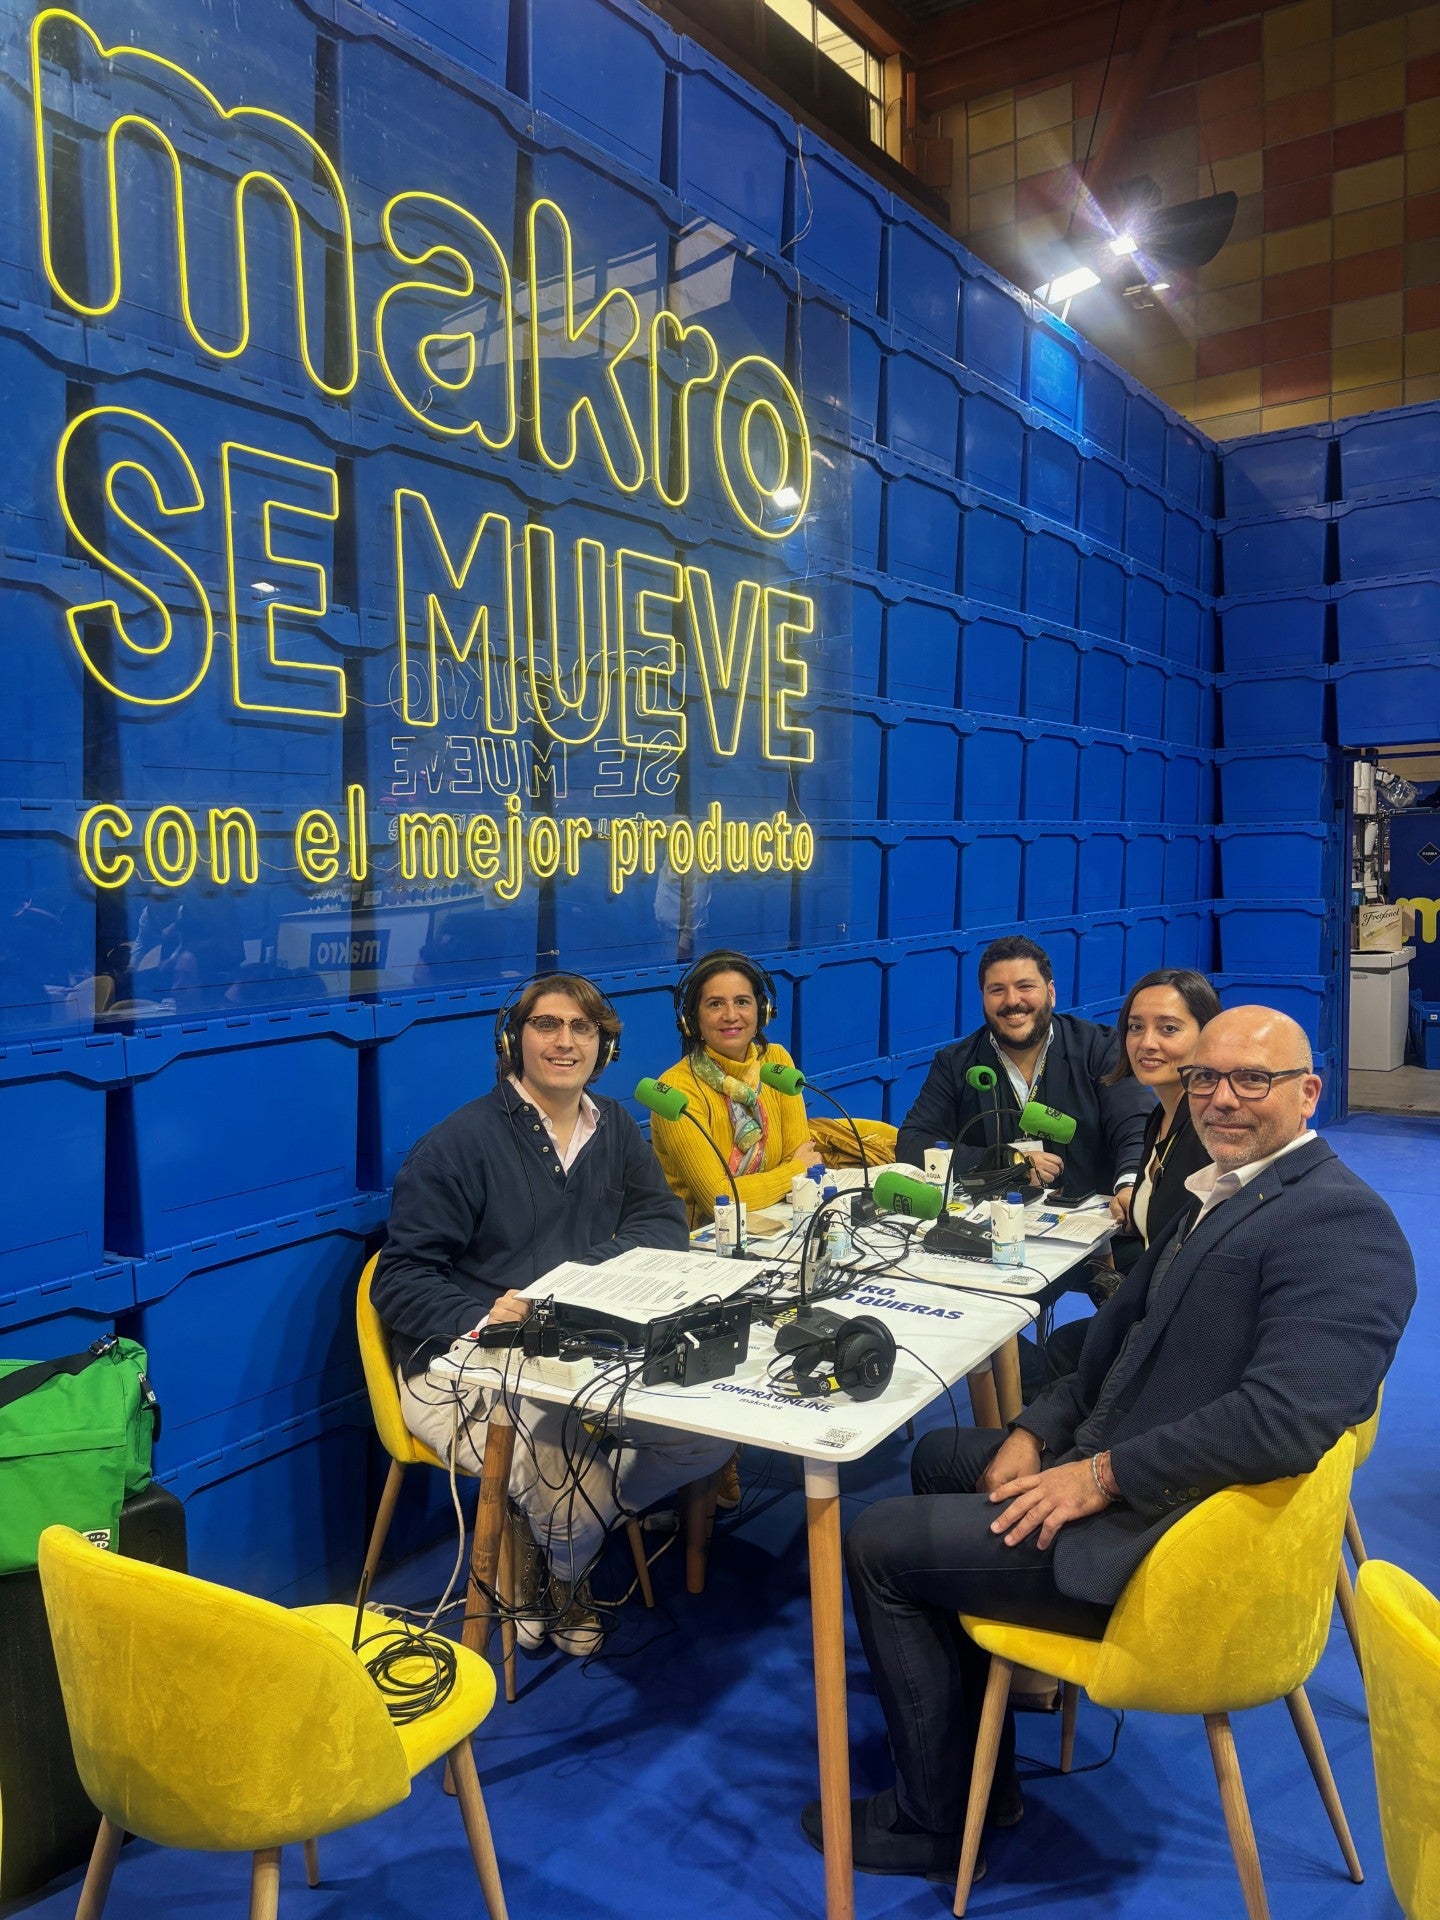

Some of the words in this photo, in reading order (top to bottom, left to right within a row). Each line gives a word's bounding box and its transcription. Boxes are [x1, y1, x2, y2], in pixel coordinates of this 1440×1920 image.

[32, 9, 811, 538] makro
[57, 406, 347, 718] SE
[395, 488, 815, 763] MUEVE
[79, 804, 259, 888] con
[295, 784, 367, 882] el
[390, 795, 592, 899] mejor
[611, 801, 814, 894] producto
[855, 1296, 964, 1320] QUIERAS
[712, 1382, 772, 1401] COMPRA
[773, 1395, 835, 1413] ONLINE
